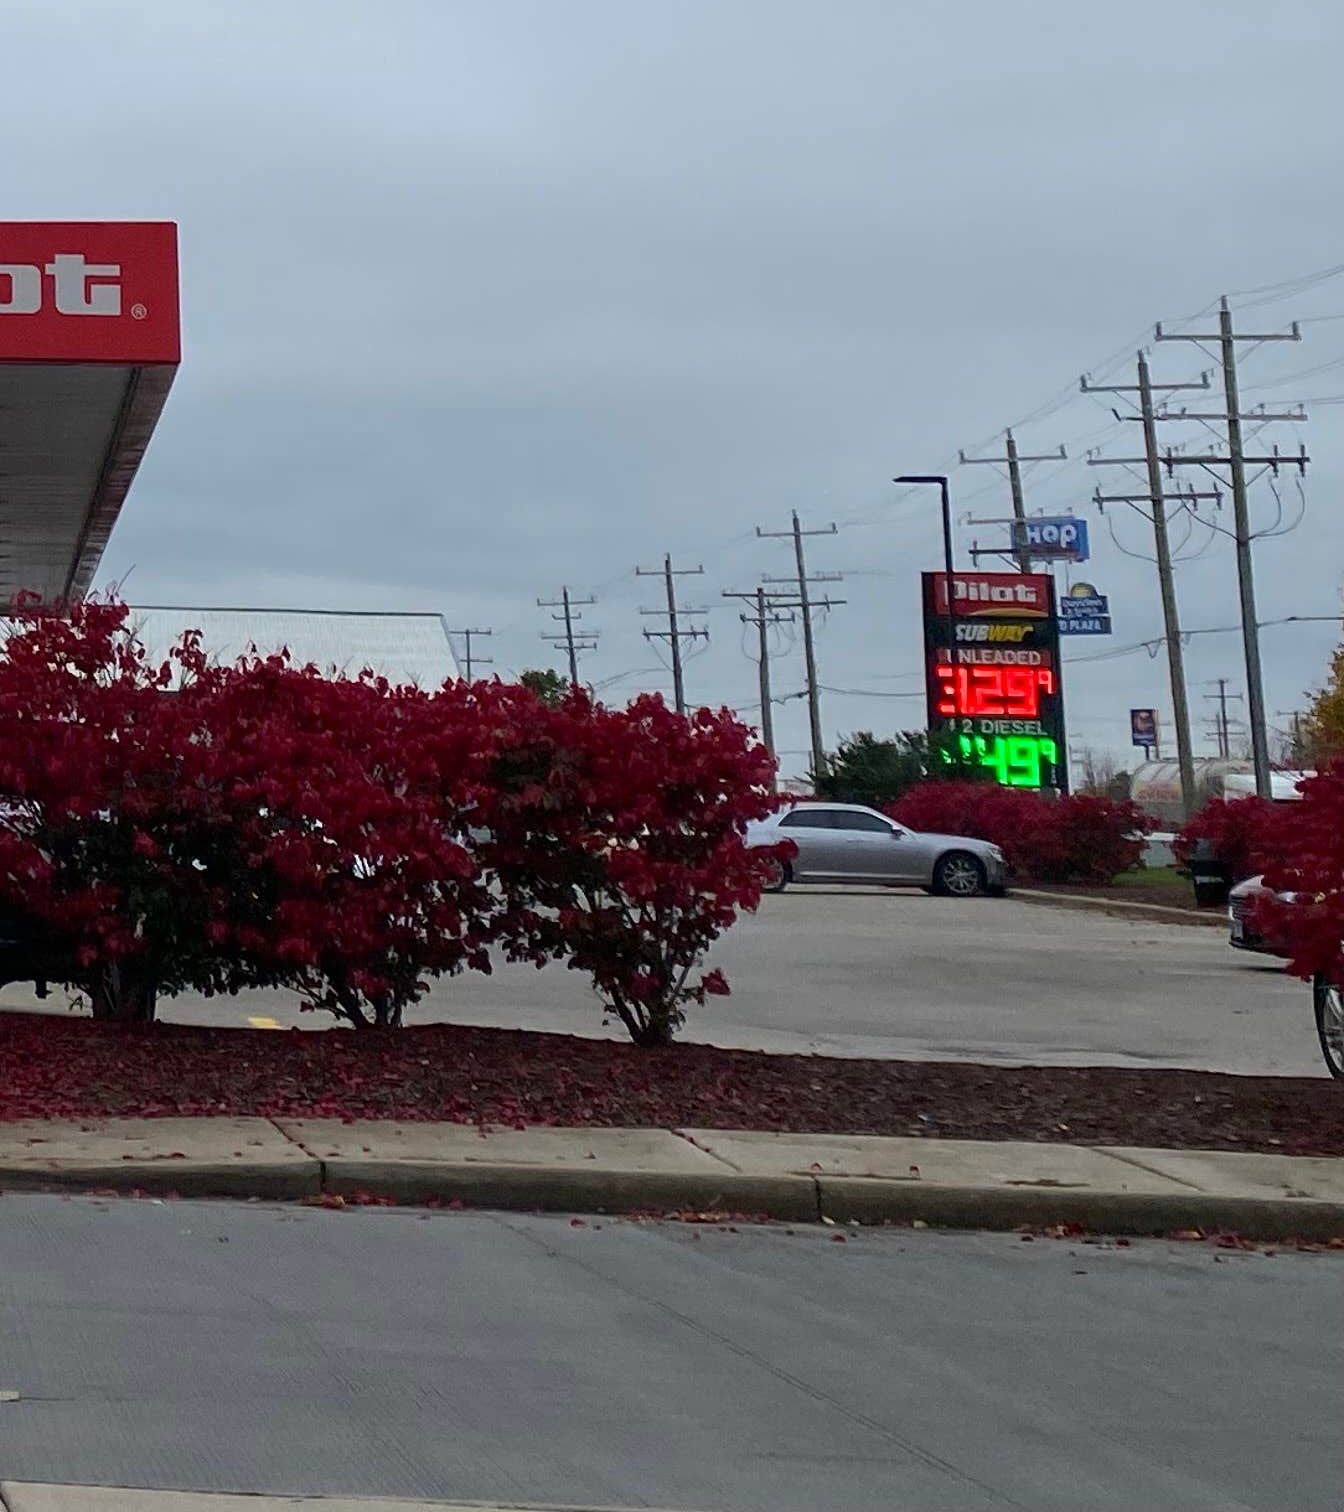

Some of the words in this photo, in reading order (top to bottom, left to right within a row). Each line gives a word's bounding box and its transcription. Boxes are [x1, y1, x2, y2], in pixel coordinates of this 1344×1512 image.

[1020, 524, 1077, 548] HOP
[955, 624, 1034, 642] SUBWAY
[980, 719, 1048, 735] DIESEL
